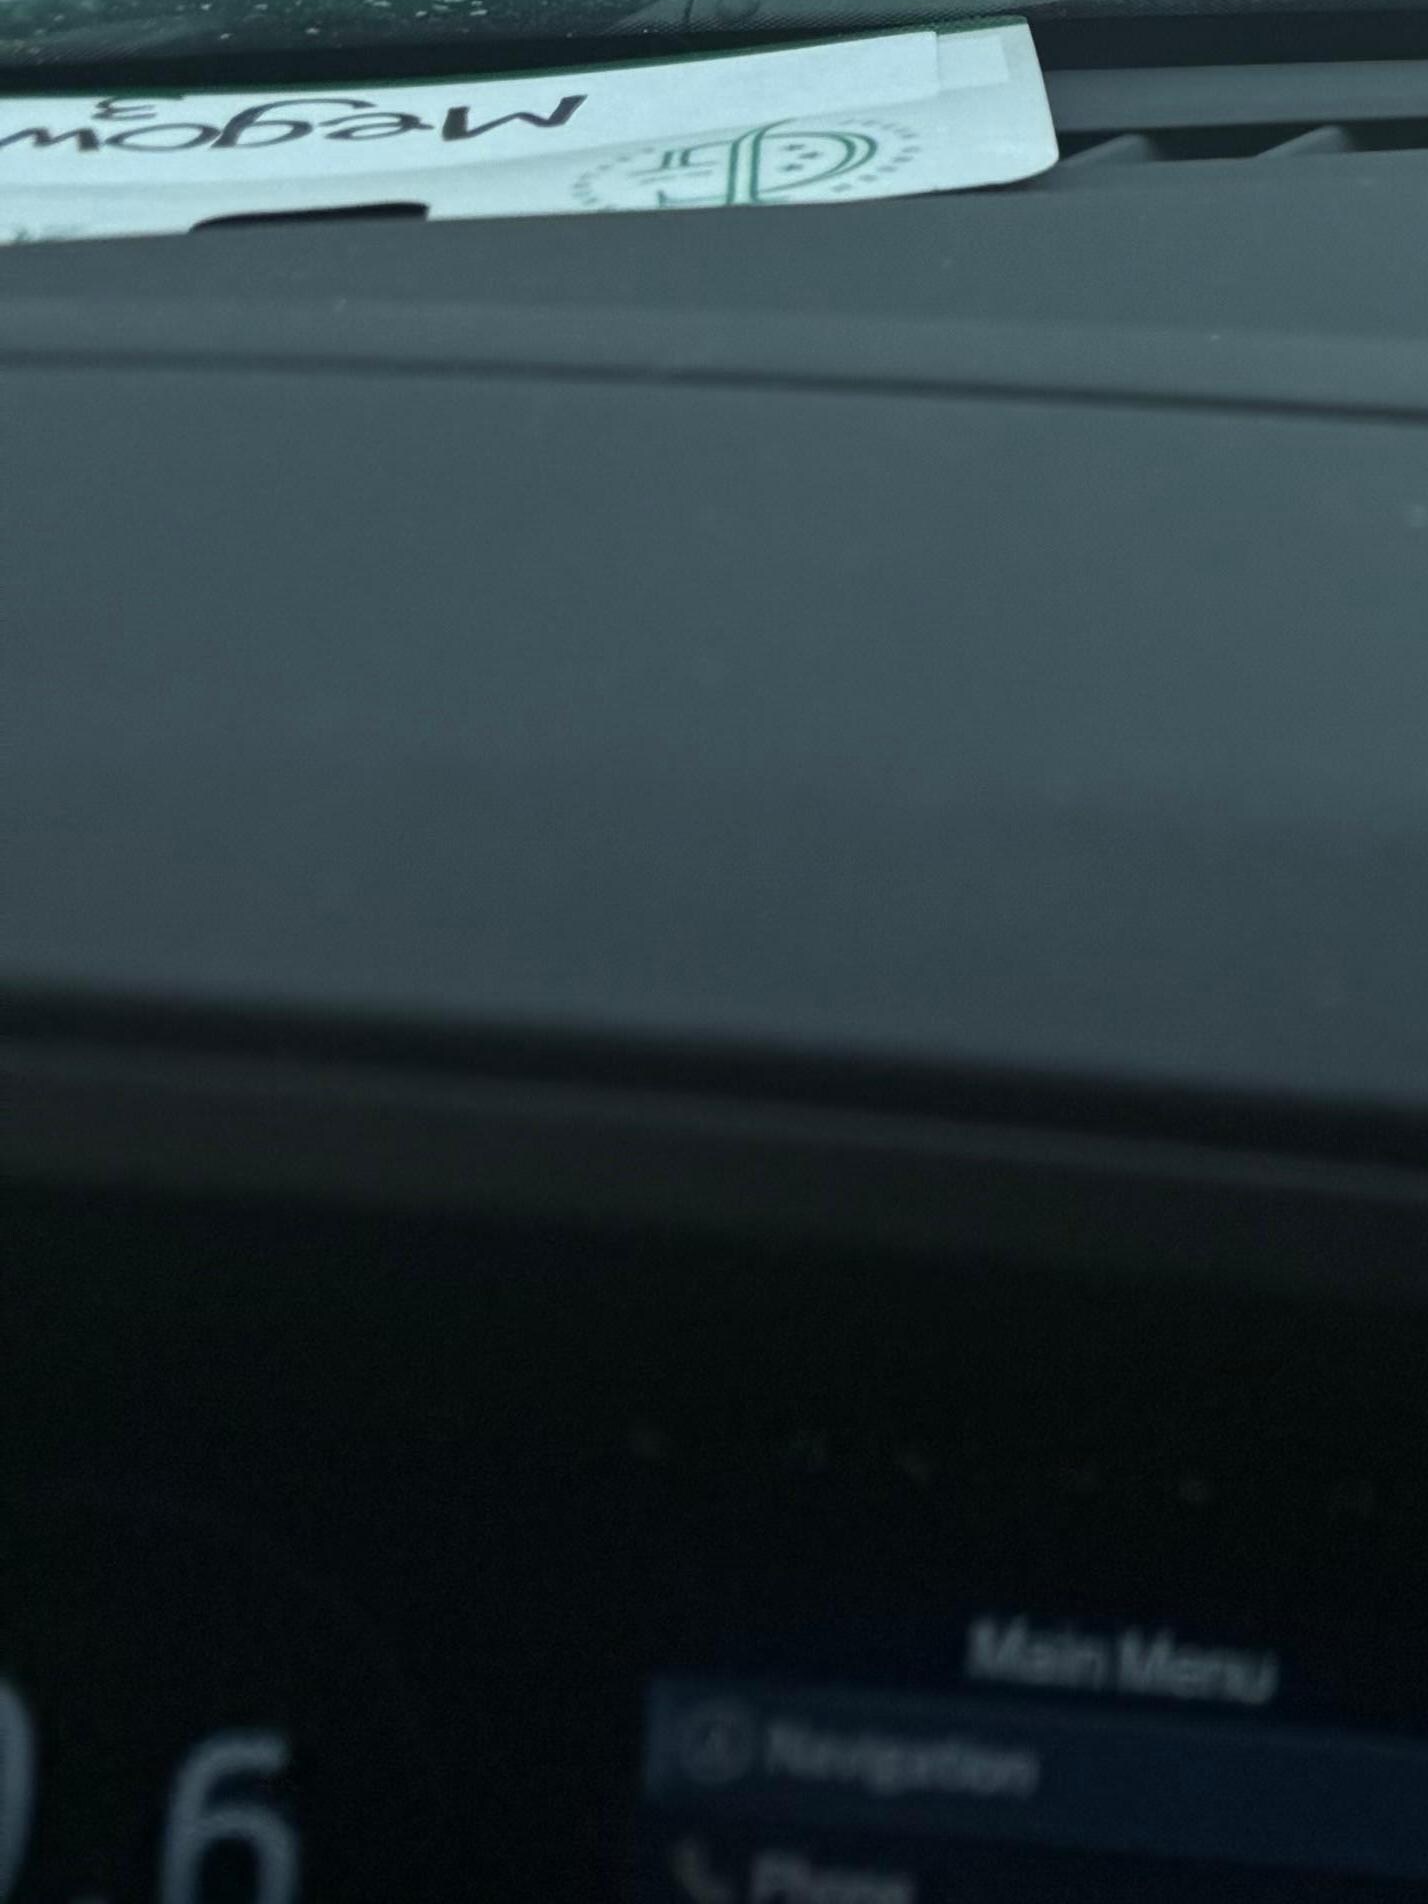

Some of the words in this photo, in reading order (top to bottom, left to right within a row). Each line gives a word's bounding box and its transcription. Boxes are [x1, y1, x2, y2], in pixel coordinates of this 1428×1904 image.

[965, 1616, 1105, 1688] Main
[1115, 1626, 1280, 1704] Menu
[767, 1720, 1039, 1798] Navigation
